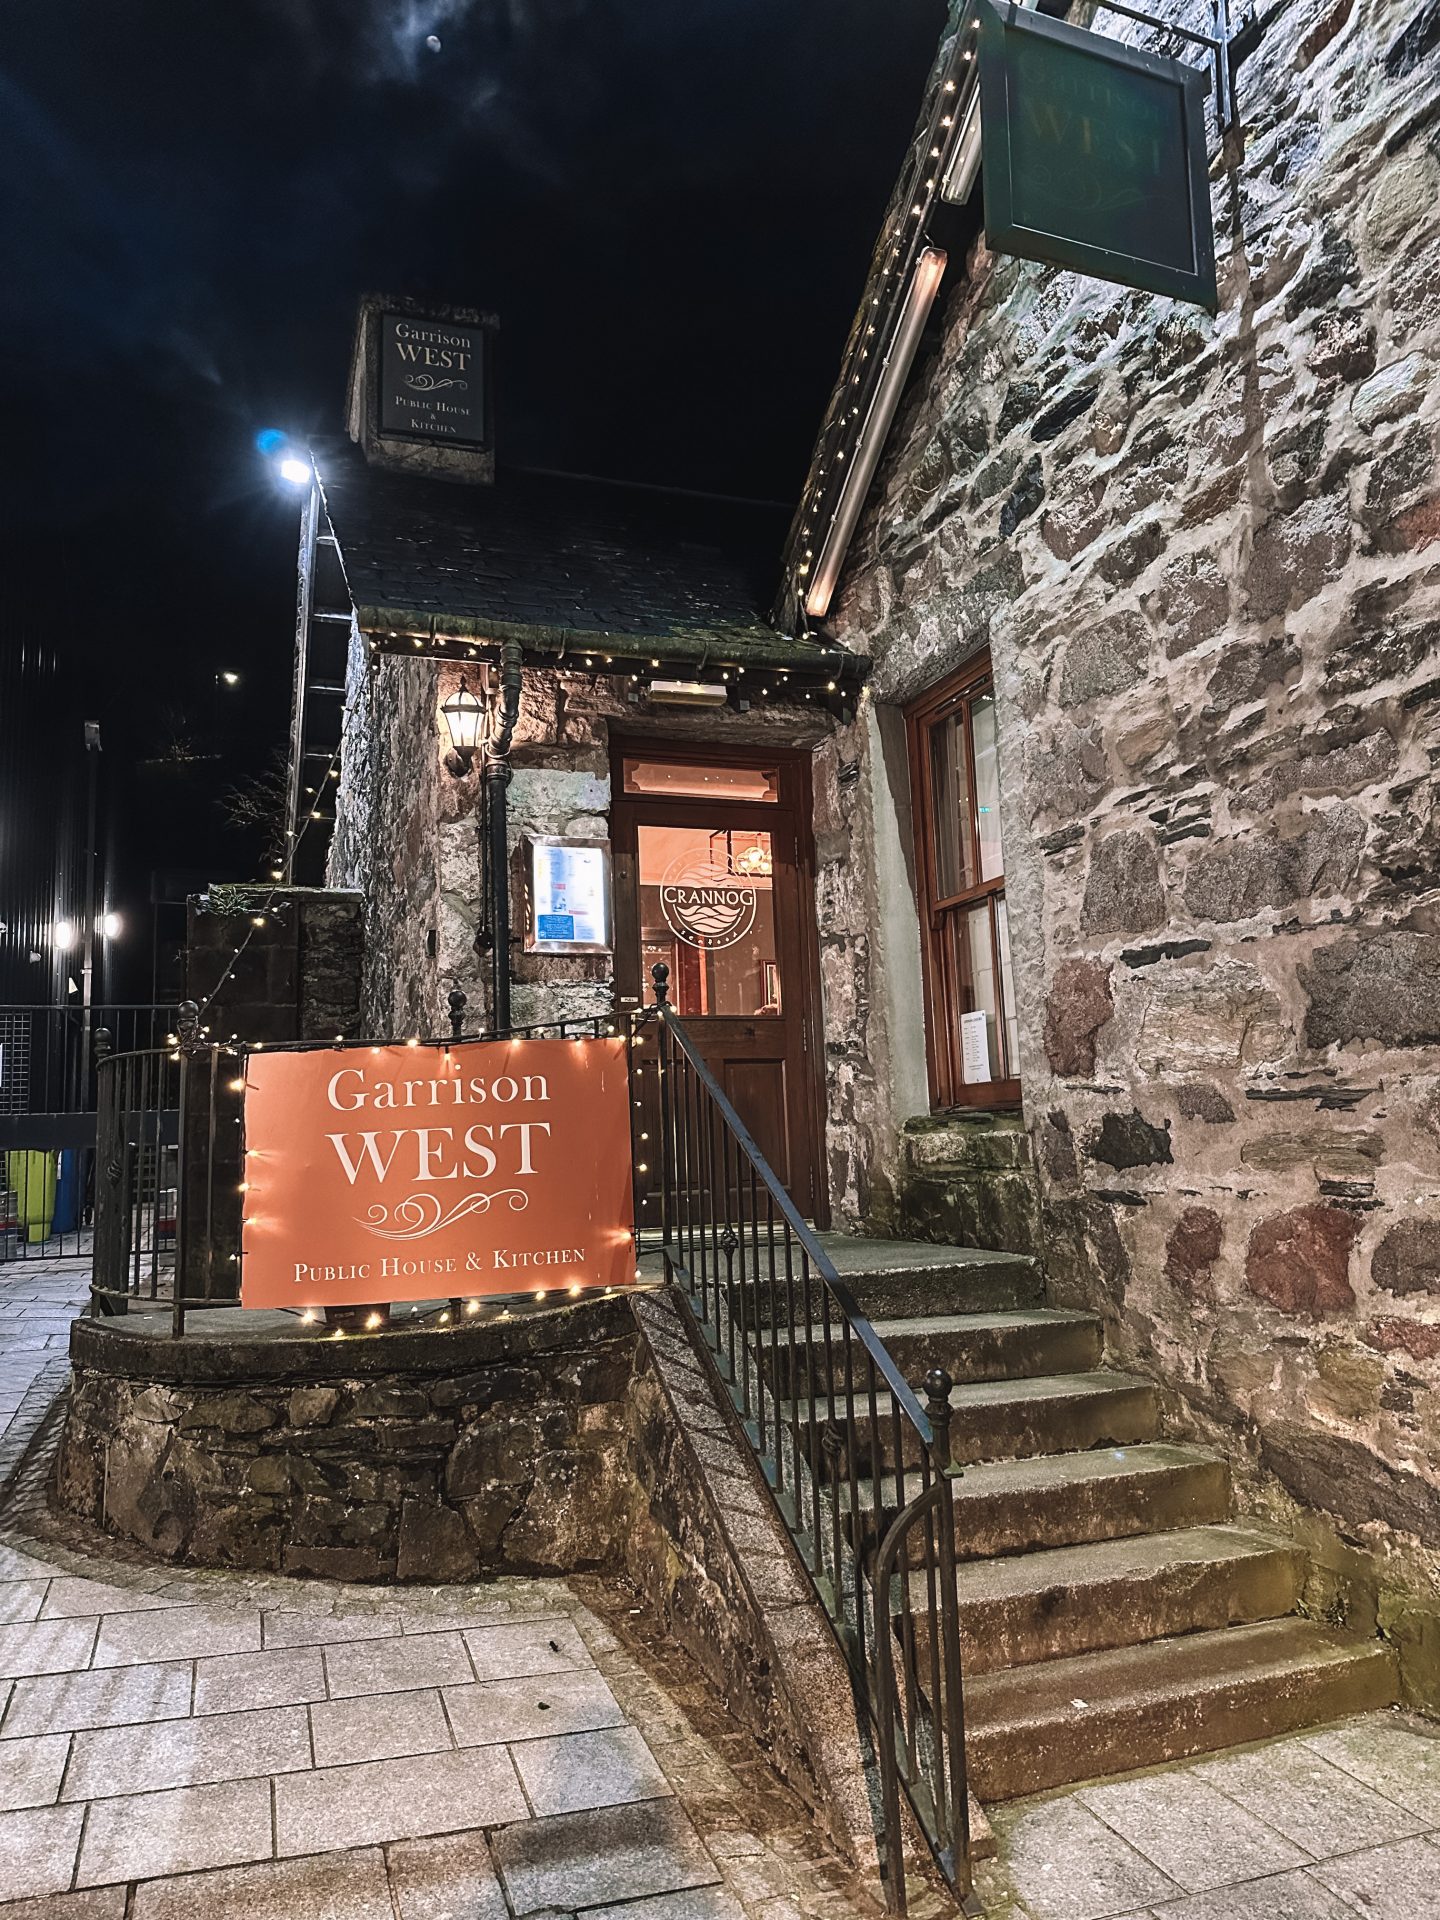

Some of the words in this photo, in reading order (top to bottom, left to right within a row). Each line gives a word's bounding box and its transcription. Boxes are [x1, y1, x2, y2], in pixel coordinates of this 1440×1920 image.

[395, 323, 470, 348] Garrison
[396, 342, 471, 370] WEST
[395, 396, 431, 409] PUBLIC
[436, 402, 470, 415] HOUSE
[411, 418, 456, 433] KITCHEN
[664, 887, 753, 906] CRANNOG
[327, 1063, 550, 1111] Garrison
[325, 1122, 551, 1184] WEST
[294, 1262, 370, 1283] PUBLIC
[380, 1257, 457, 1278] HOUSE
[465, 1252, 482, 1271] &
[493, 1248, 586, 1269] KITCHEN
